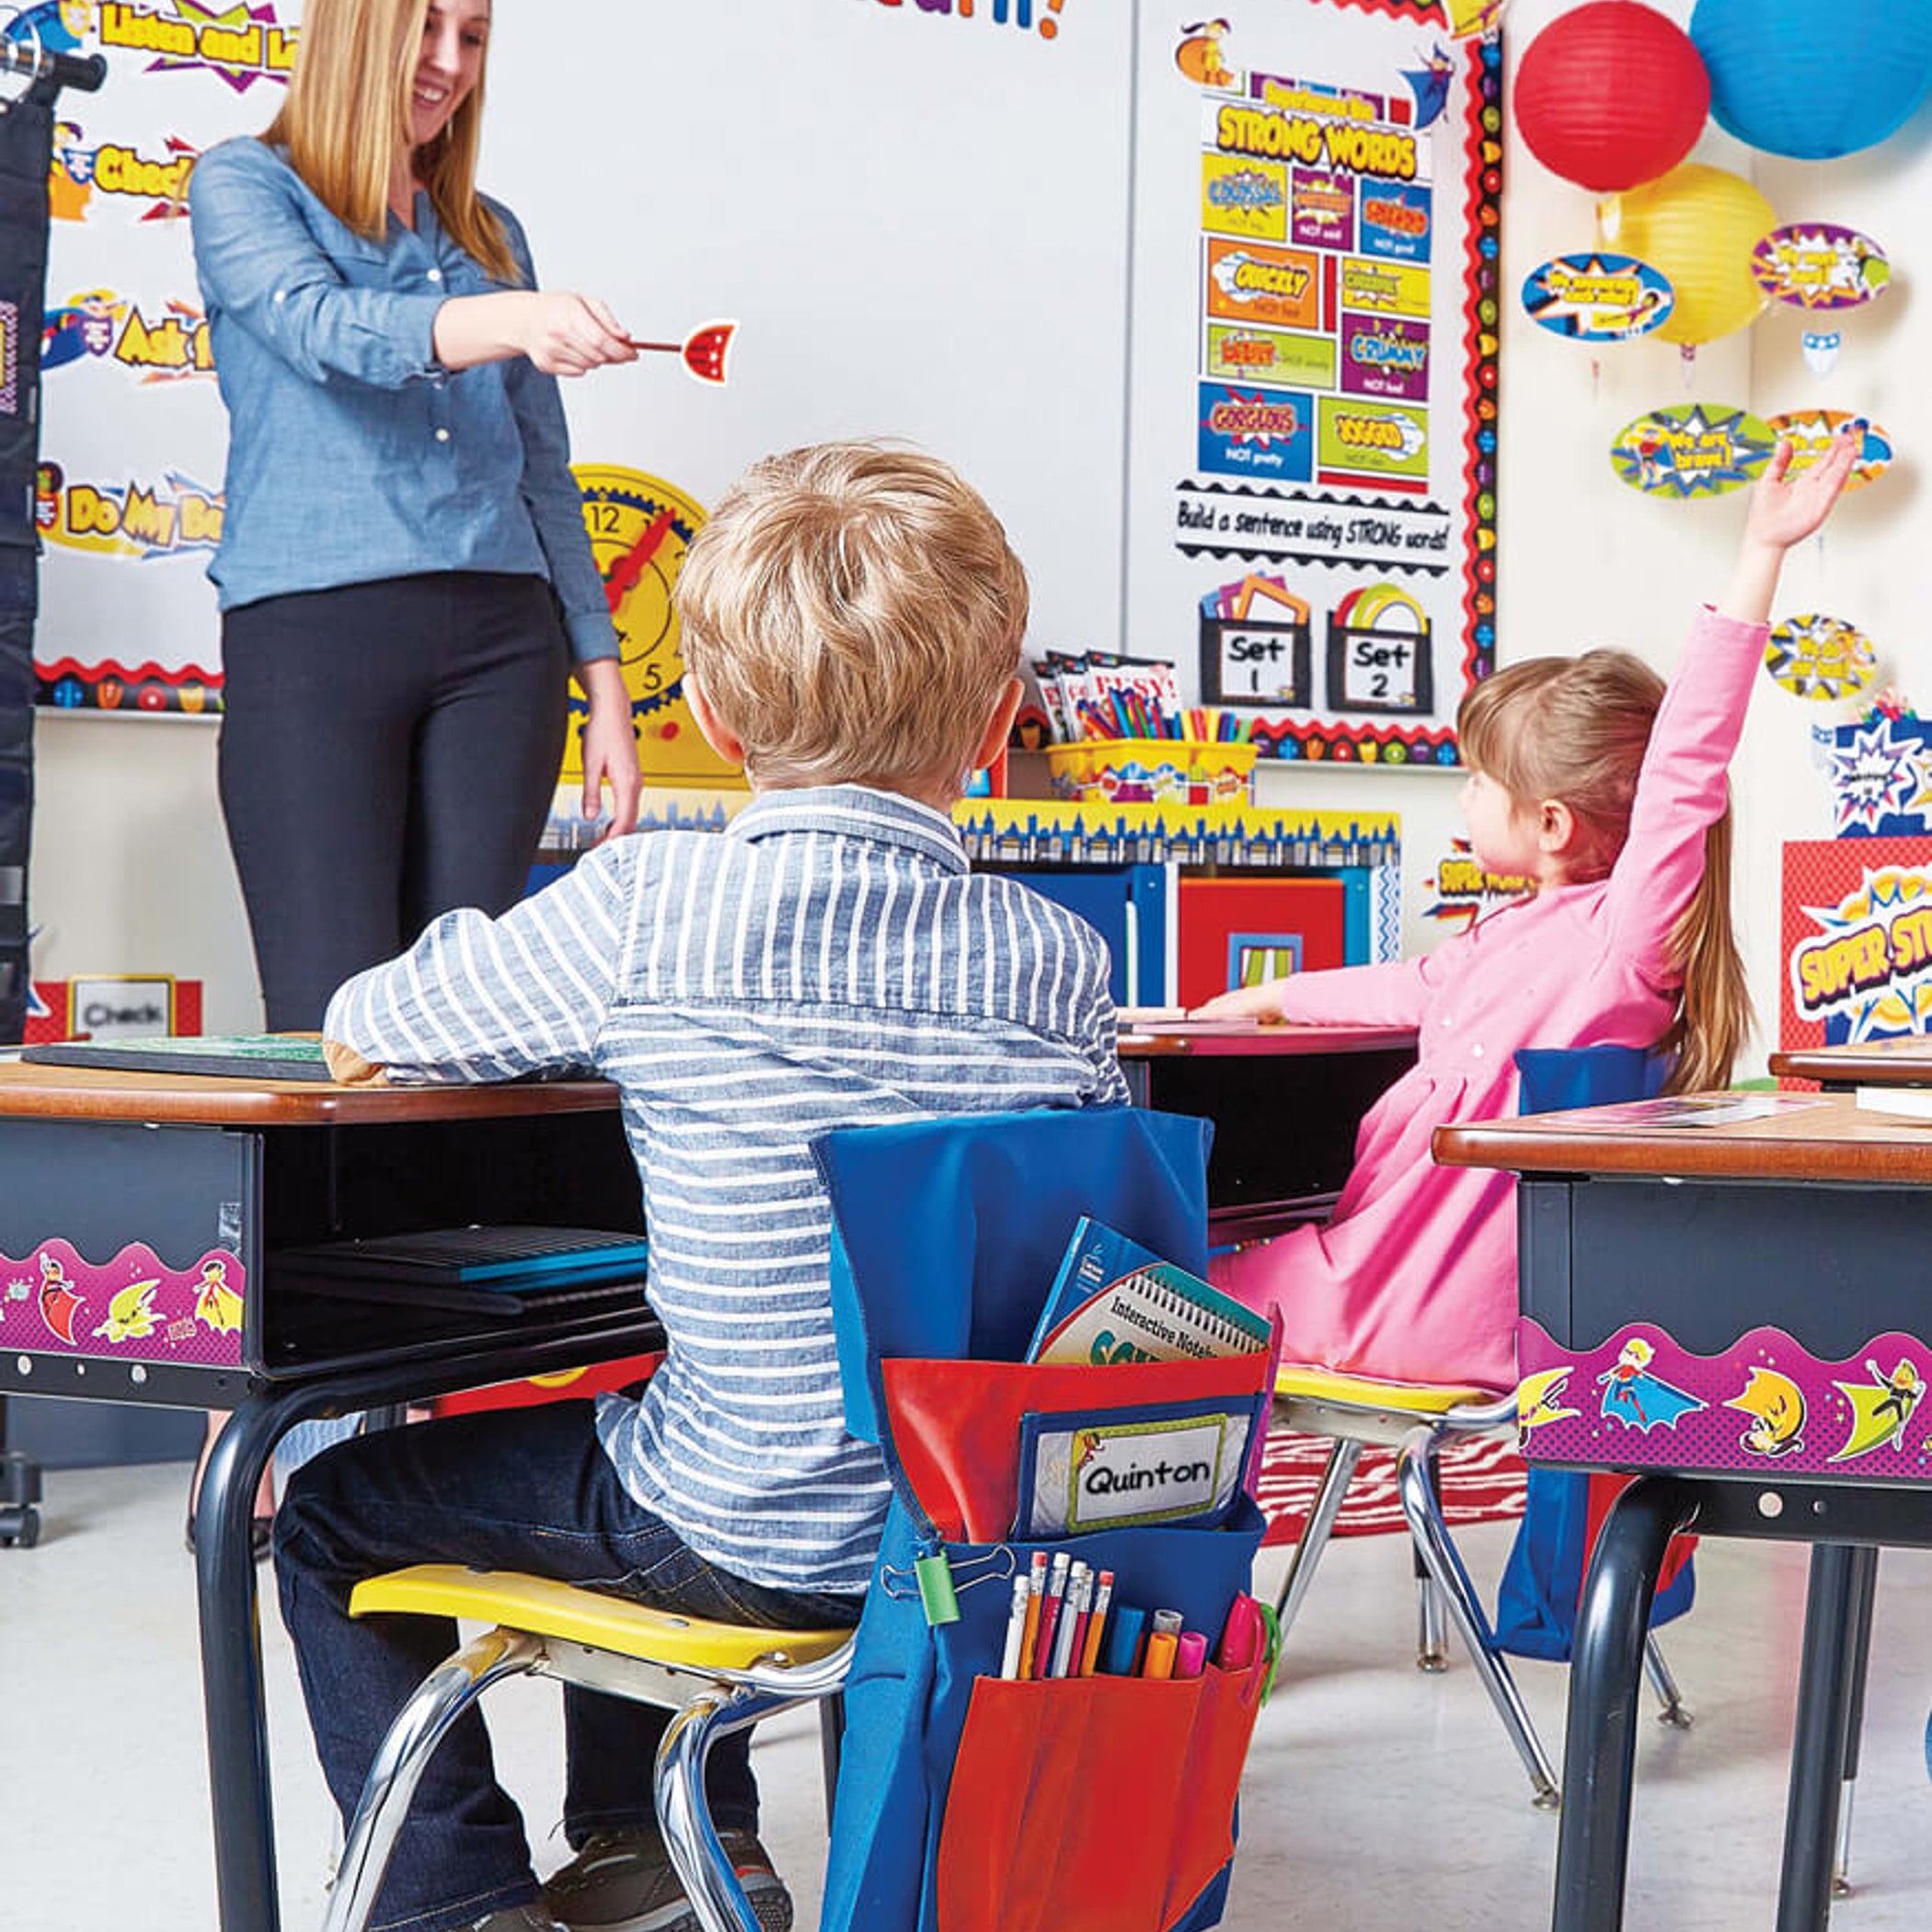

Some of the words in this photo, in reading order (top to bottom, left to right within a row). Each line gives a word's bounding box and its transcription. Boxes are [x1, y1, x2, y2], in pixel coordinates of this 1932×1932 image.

[99, 3, 197, 57] Listen
[199, 24, 263, 67] and
[1217, 103, 1323, 167] STRONG
[1322, 122, 1417, 181] WORDS
[1233, 260, 1311, 300] QUICKLY
[113, 303, 191, 369] Ask
[1213, 404, 1295, 434] GORGEOUS
[1225, 448, 1251, 462] NOT
[66, 484, 121, 535] Do
[121, 479, 178, 548] My
[591, 504, 621, 534] 12
[1177, 500, 1215, 531] Build
[1218, 512, 1229, 531] a
[1234, 512, 1304, 538] sentence
[1305, 514, 1344, 549] using
[1346, 519, 1402, 547] STRONG
[1229, 636, 1284, 662] Set
[1352, 642, 1410, 669] Set
[643, 663, 662, 691] 5
[1371, 674, 1389, 698] 2
[1798, 923, 1892, 1011] SUPER
[1110, 1294, 1177, 1344] Interactive
[1085, 1460, 1211, 1495] Quinton
